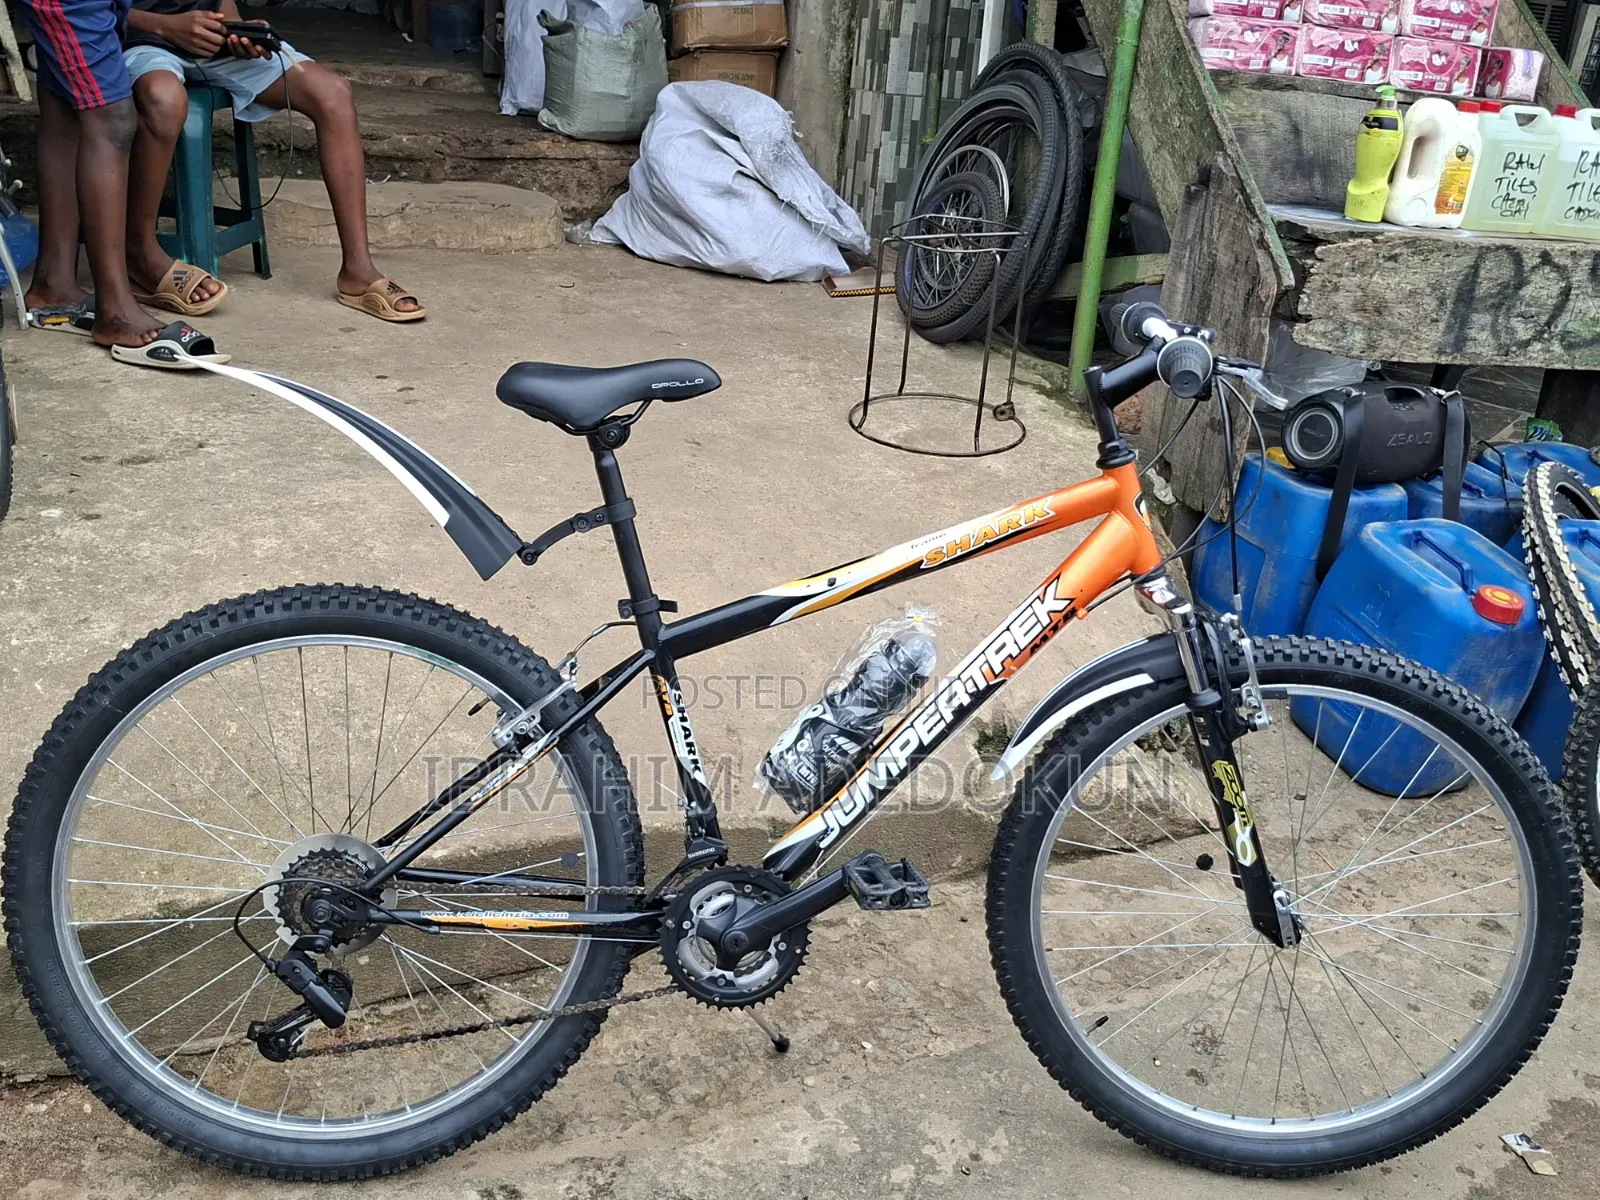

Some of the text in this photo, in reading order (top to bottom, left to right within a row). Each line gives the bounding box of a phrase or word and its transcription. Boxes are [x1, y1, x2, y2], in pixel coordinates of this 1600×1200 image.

[1387, 431, 1435, 447] ZEALO
[921, 498, 1053, 567] SHARK
[673, 689, 702, 773] SHARK
[818, 580, 1072, 848] JUMPERTREK
